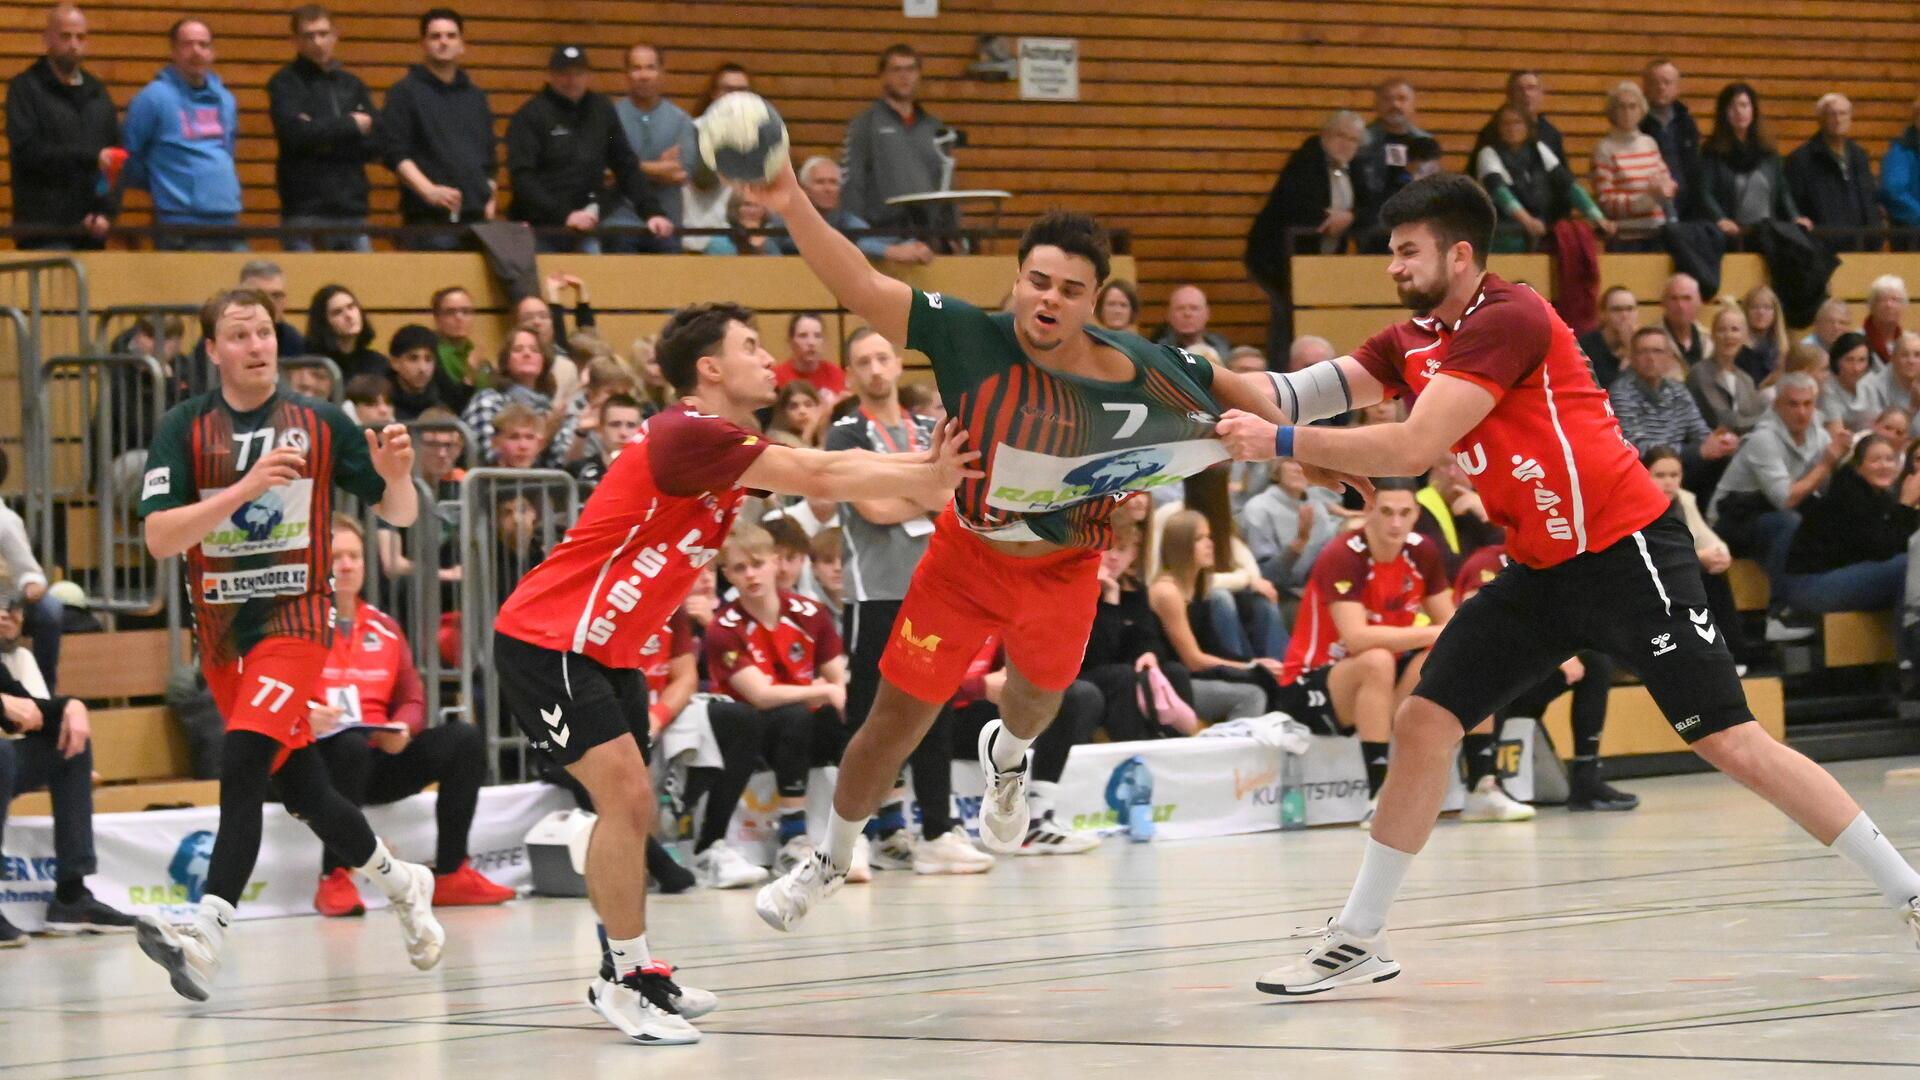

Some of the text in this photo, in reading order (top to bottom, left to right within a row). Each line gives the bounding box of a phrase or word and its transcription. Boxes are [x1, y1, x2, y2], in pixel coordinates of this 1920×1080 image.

[1101, 403, 1149, 440] 7
[232, 427, 276, 471] 77
[250, 675, 295, 713] 77
